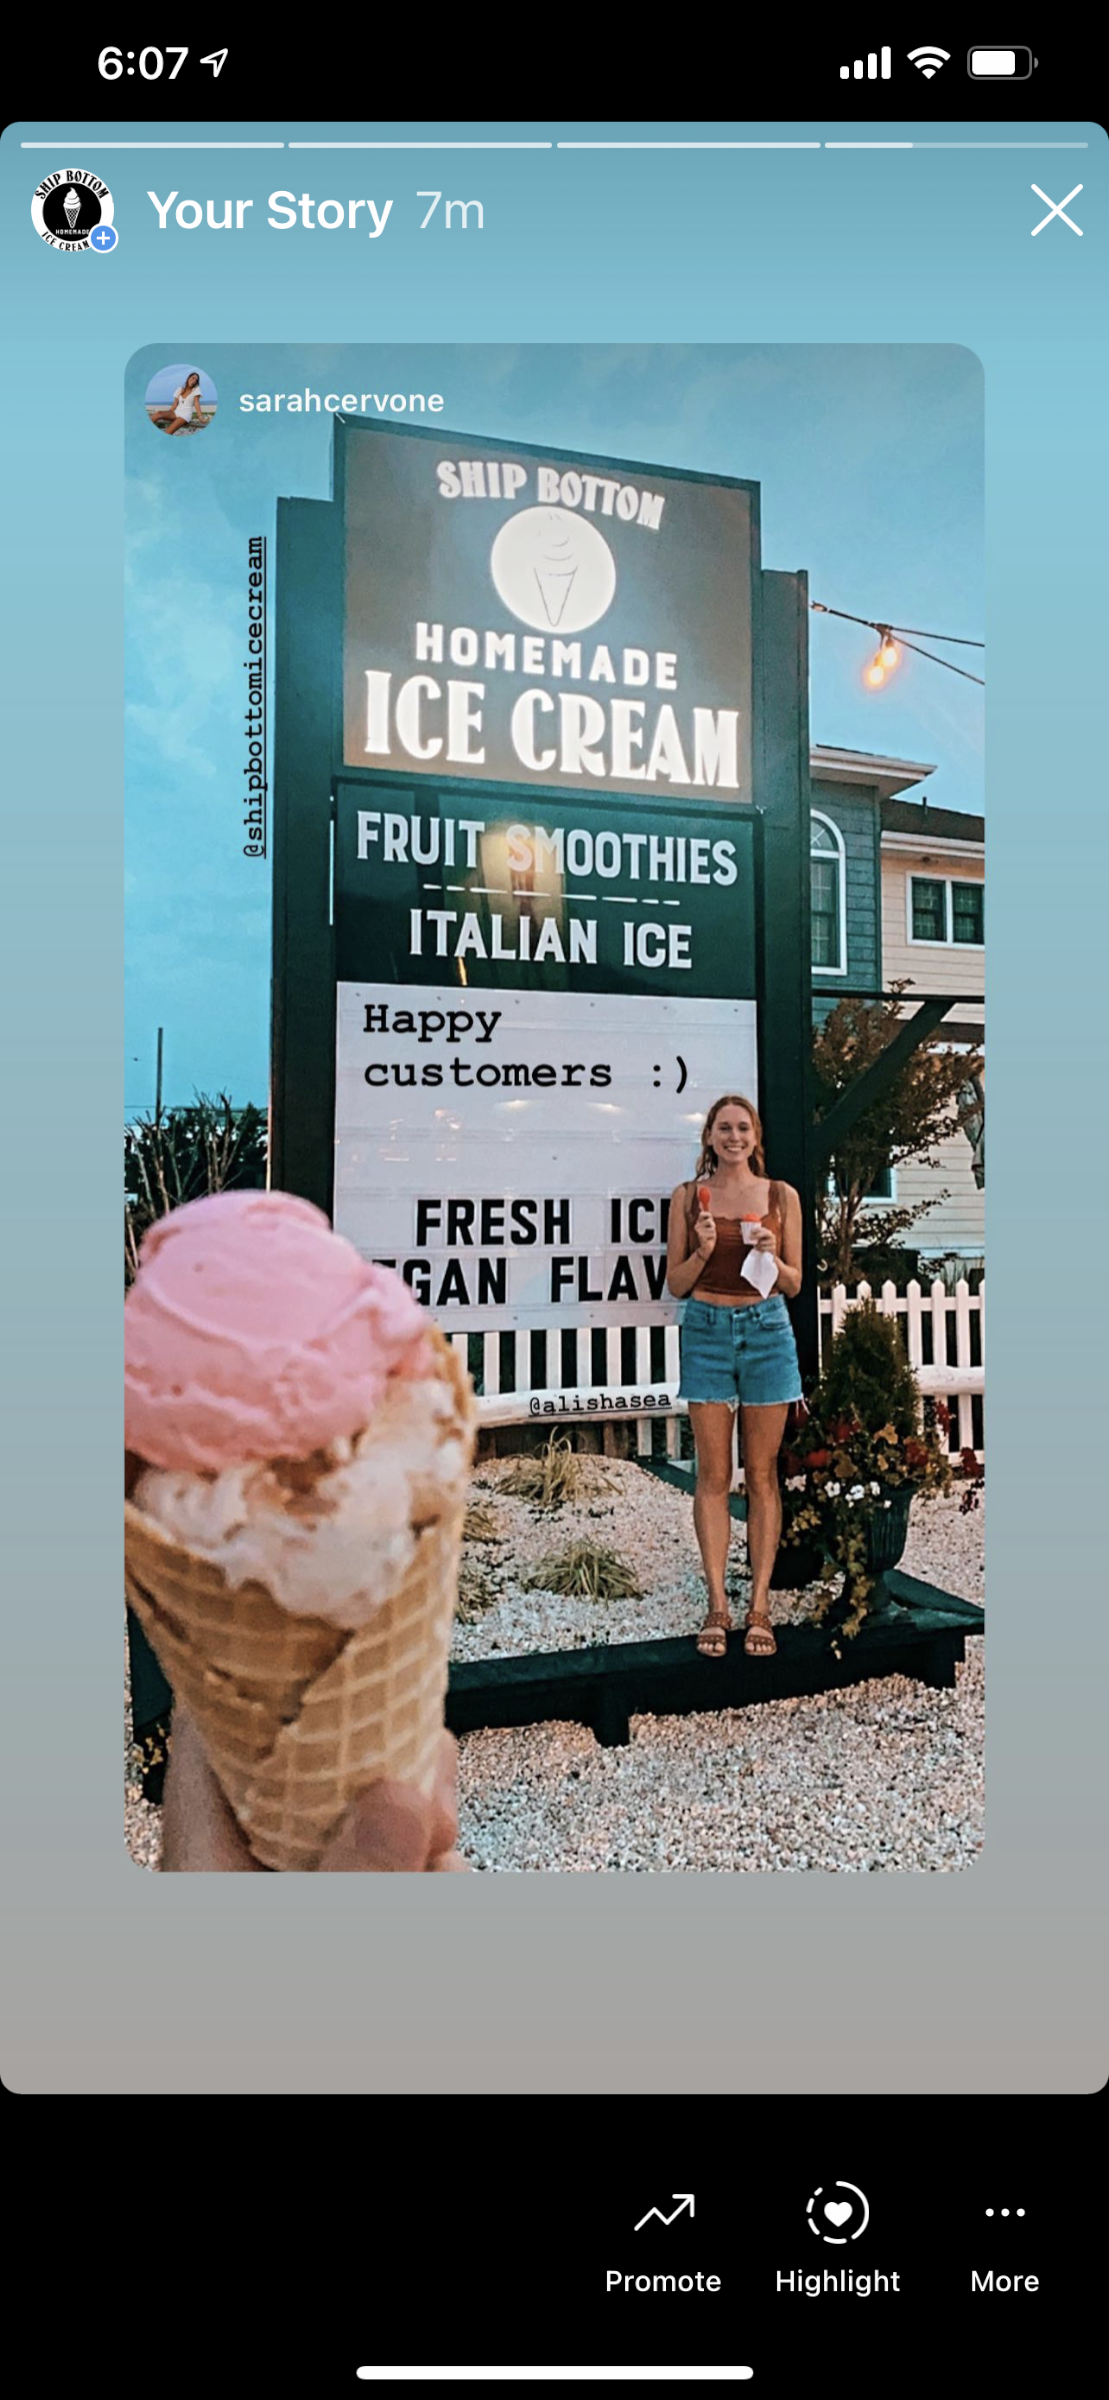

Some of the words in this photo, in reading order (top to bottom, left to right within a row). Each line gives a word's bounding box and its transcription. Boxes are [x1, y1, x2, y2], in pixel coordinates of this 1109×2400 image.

[437, 461, 527, 499] SHIP
[538, 467, 665, 530] BOTTOM
[416, 622, 677, 690] HOMEMADE
[365, 670, 485, 764] ICE
[511, 688, 740, 788] CREAM
[357, 811, 485, 868] FRUIT
[506, 824, 738, 886] SMOOTHIES
[409, 909, 598, 964] ITALIAN
[623, 922, 692, 968] ICE
[416, 1199, 570, 1246] FRESH
[372, 1258, 507, 1306] GAN
